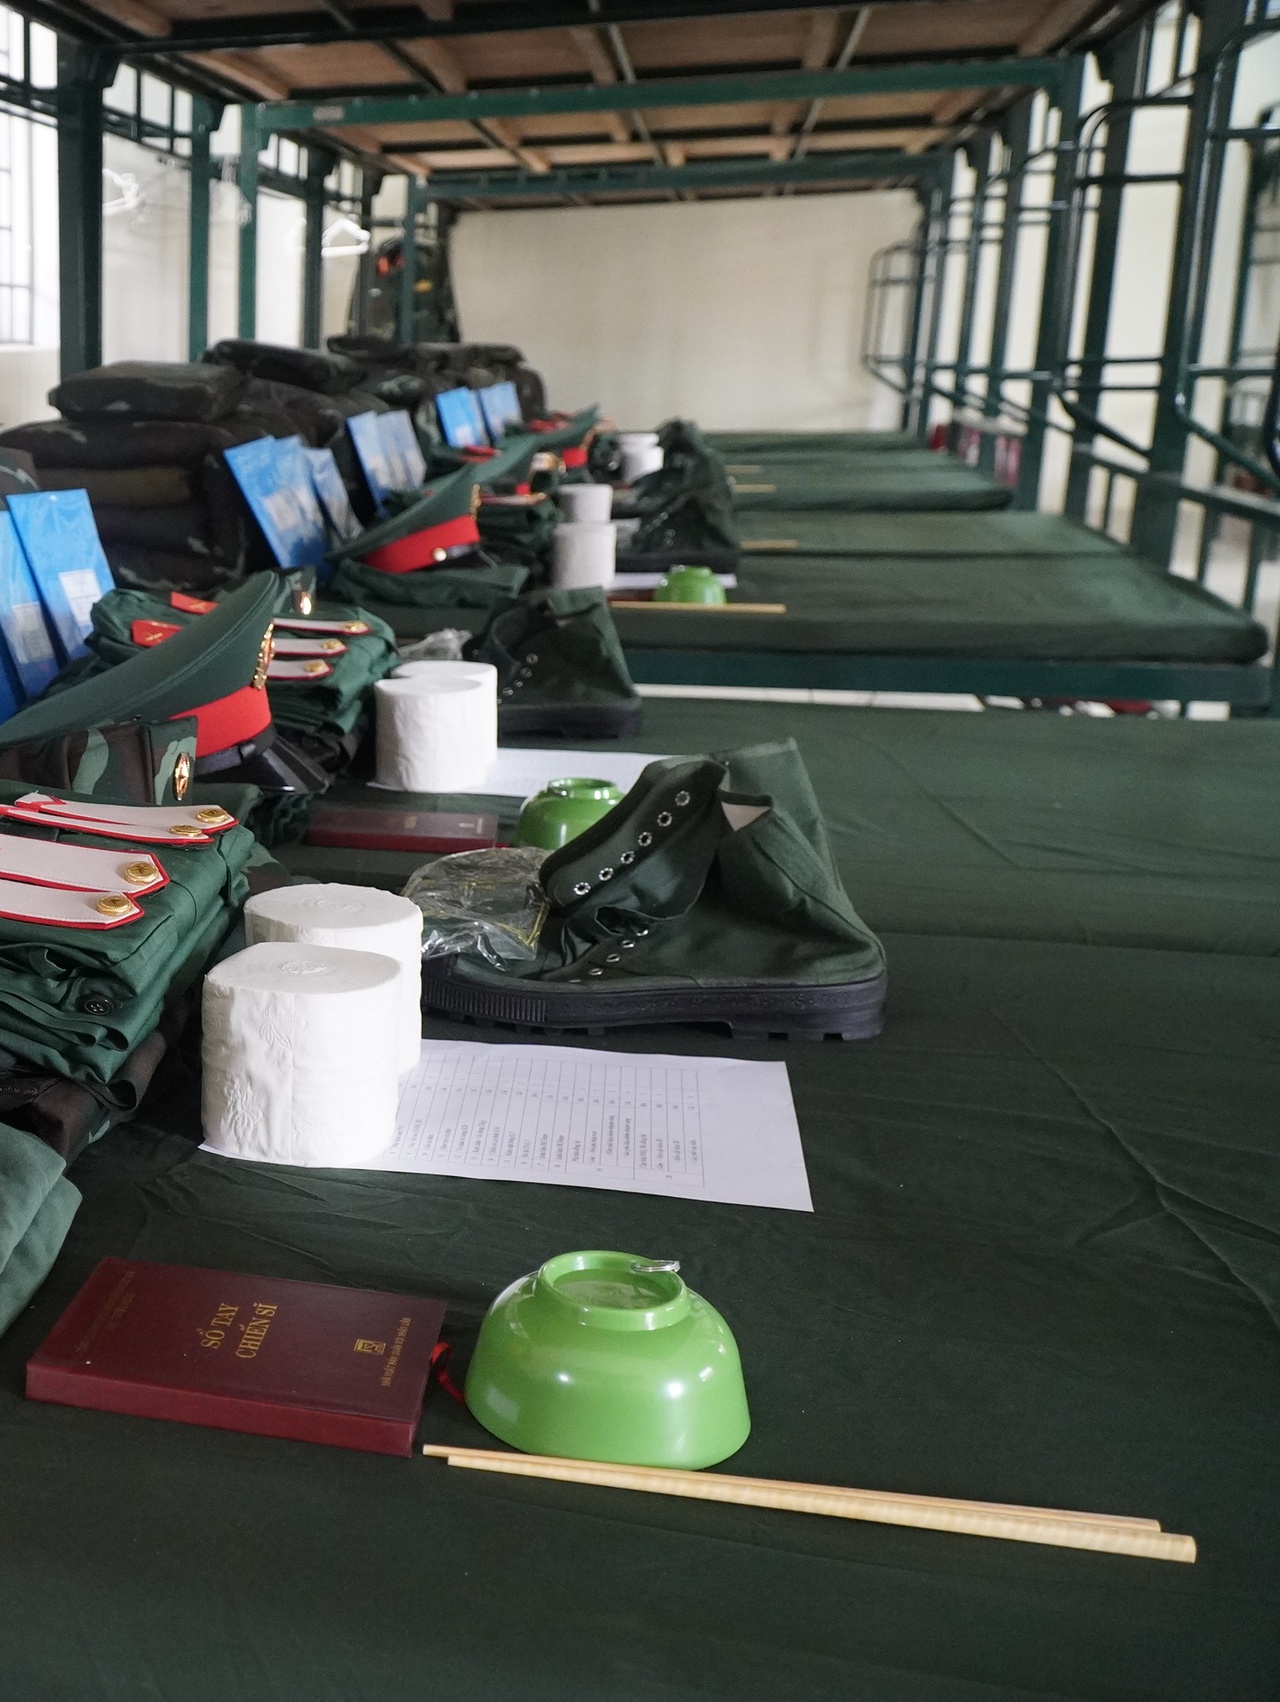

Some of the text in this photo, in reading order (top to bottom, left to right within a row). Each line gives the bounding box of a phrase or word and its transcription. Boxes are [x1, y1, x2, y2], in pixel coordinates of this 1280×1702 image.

[196, 1303, 239, 1349] SỔ TAY
[235, 1302, 278, 1359] CHIẾN SĨ
